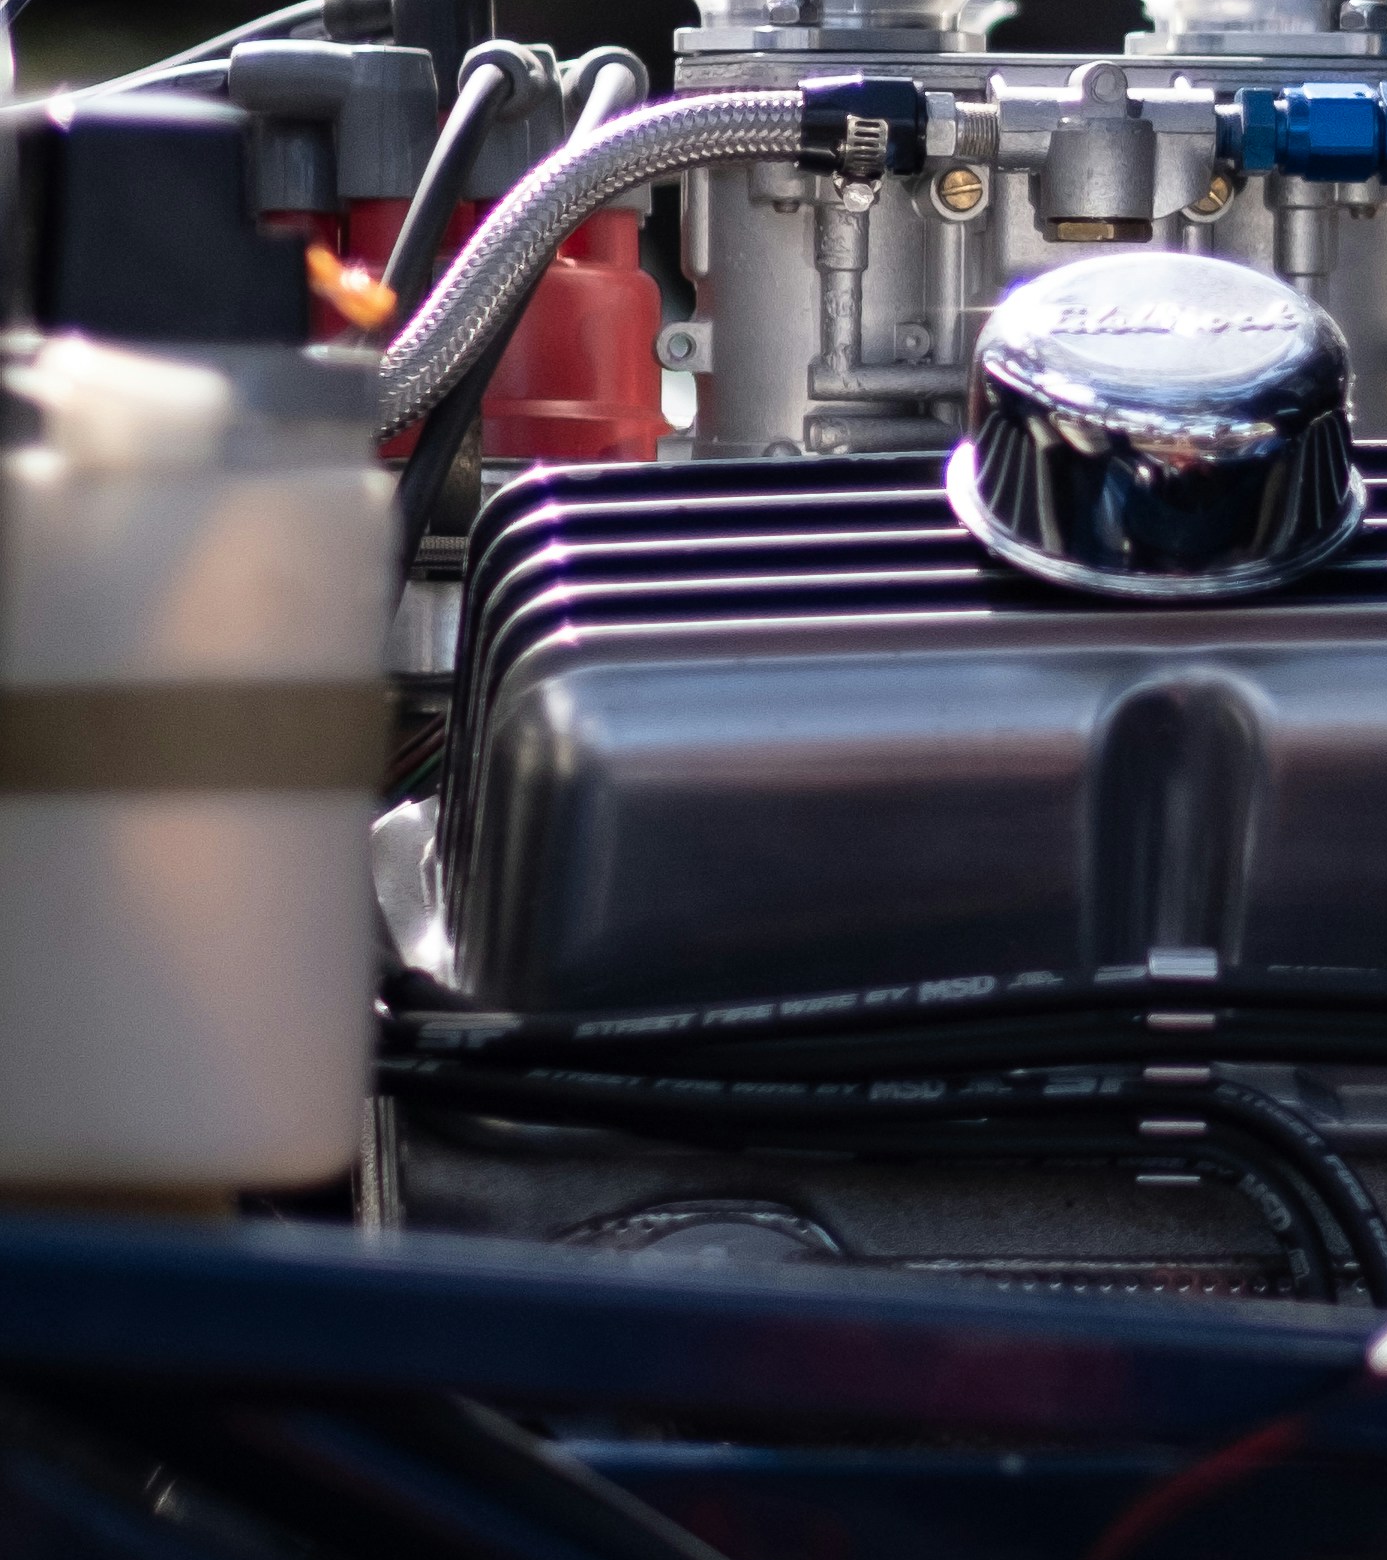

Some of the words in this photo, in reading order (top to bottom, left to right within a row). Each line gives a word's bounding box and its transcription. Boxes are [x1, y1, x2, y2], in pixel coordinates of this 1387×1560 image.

[574, 1012, 699, 1041] STREET
[702, 1003, 776, 1027] FIRE
[780, 992, 861, 1018] WIRE
[864, 985, 911, 1005] BY
[917, 975, 997, 1004] MSD
[868, 1079, 948, 1102] MSD
